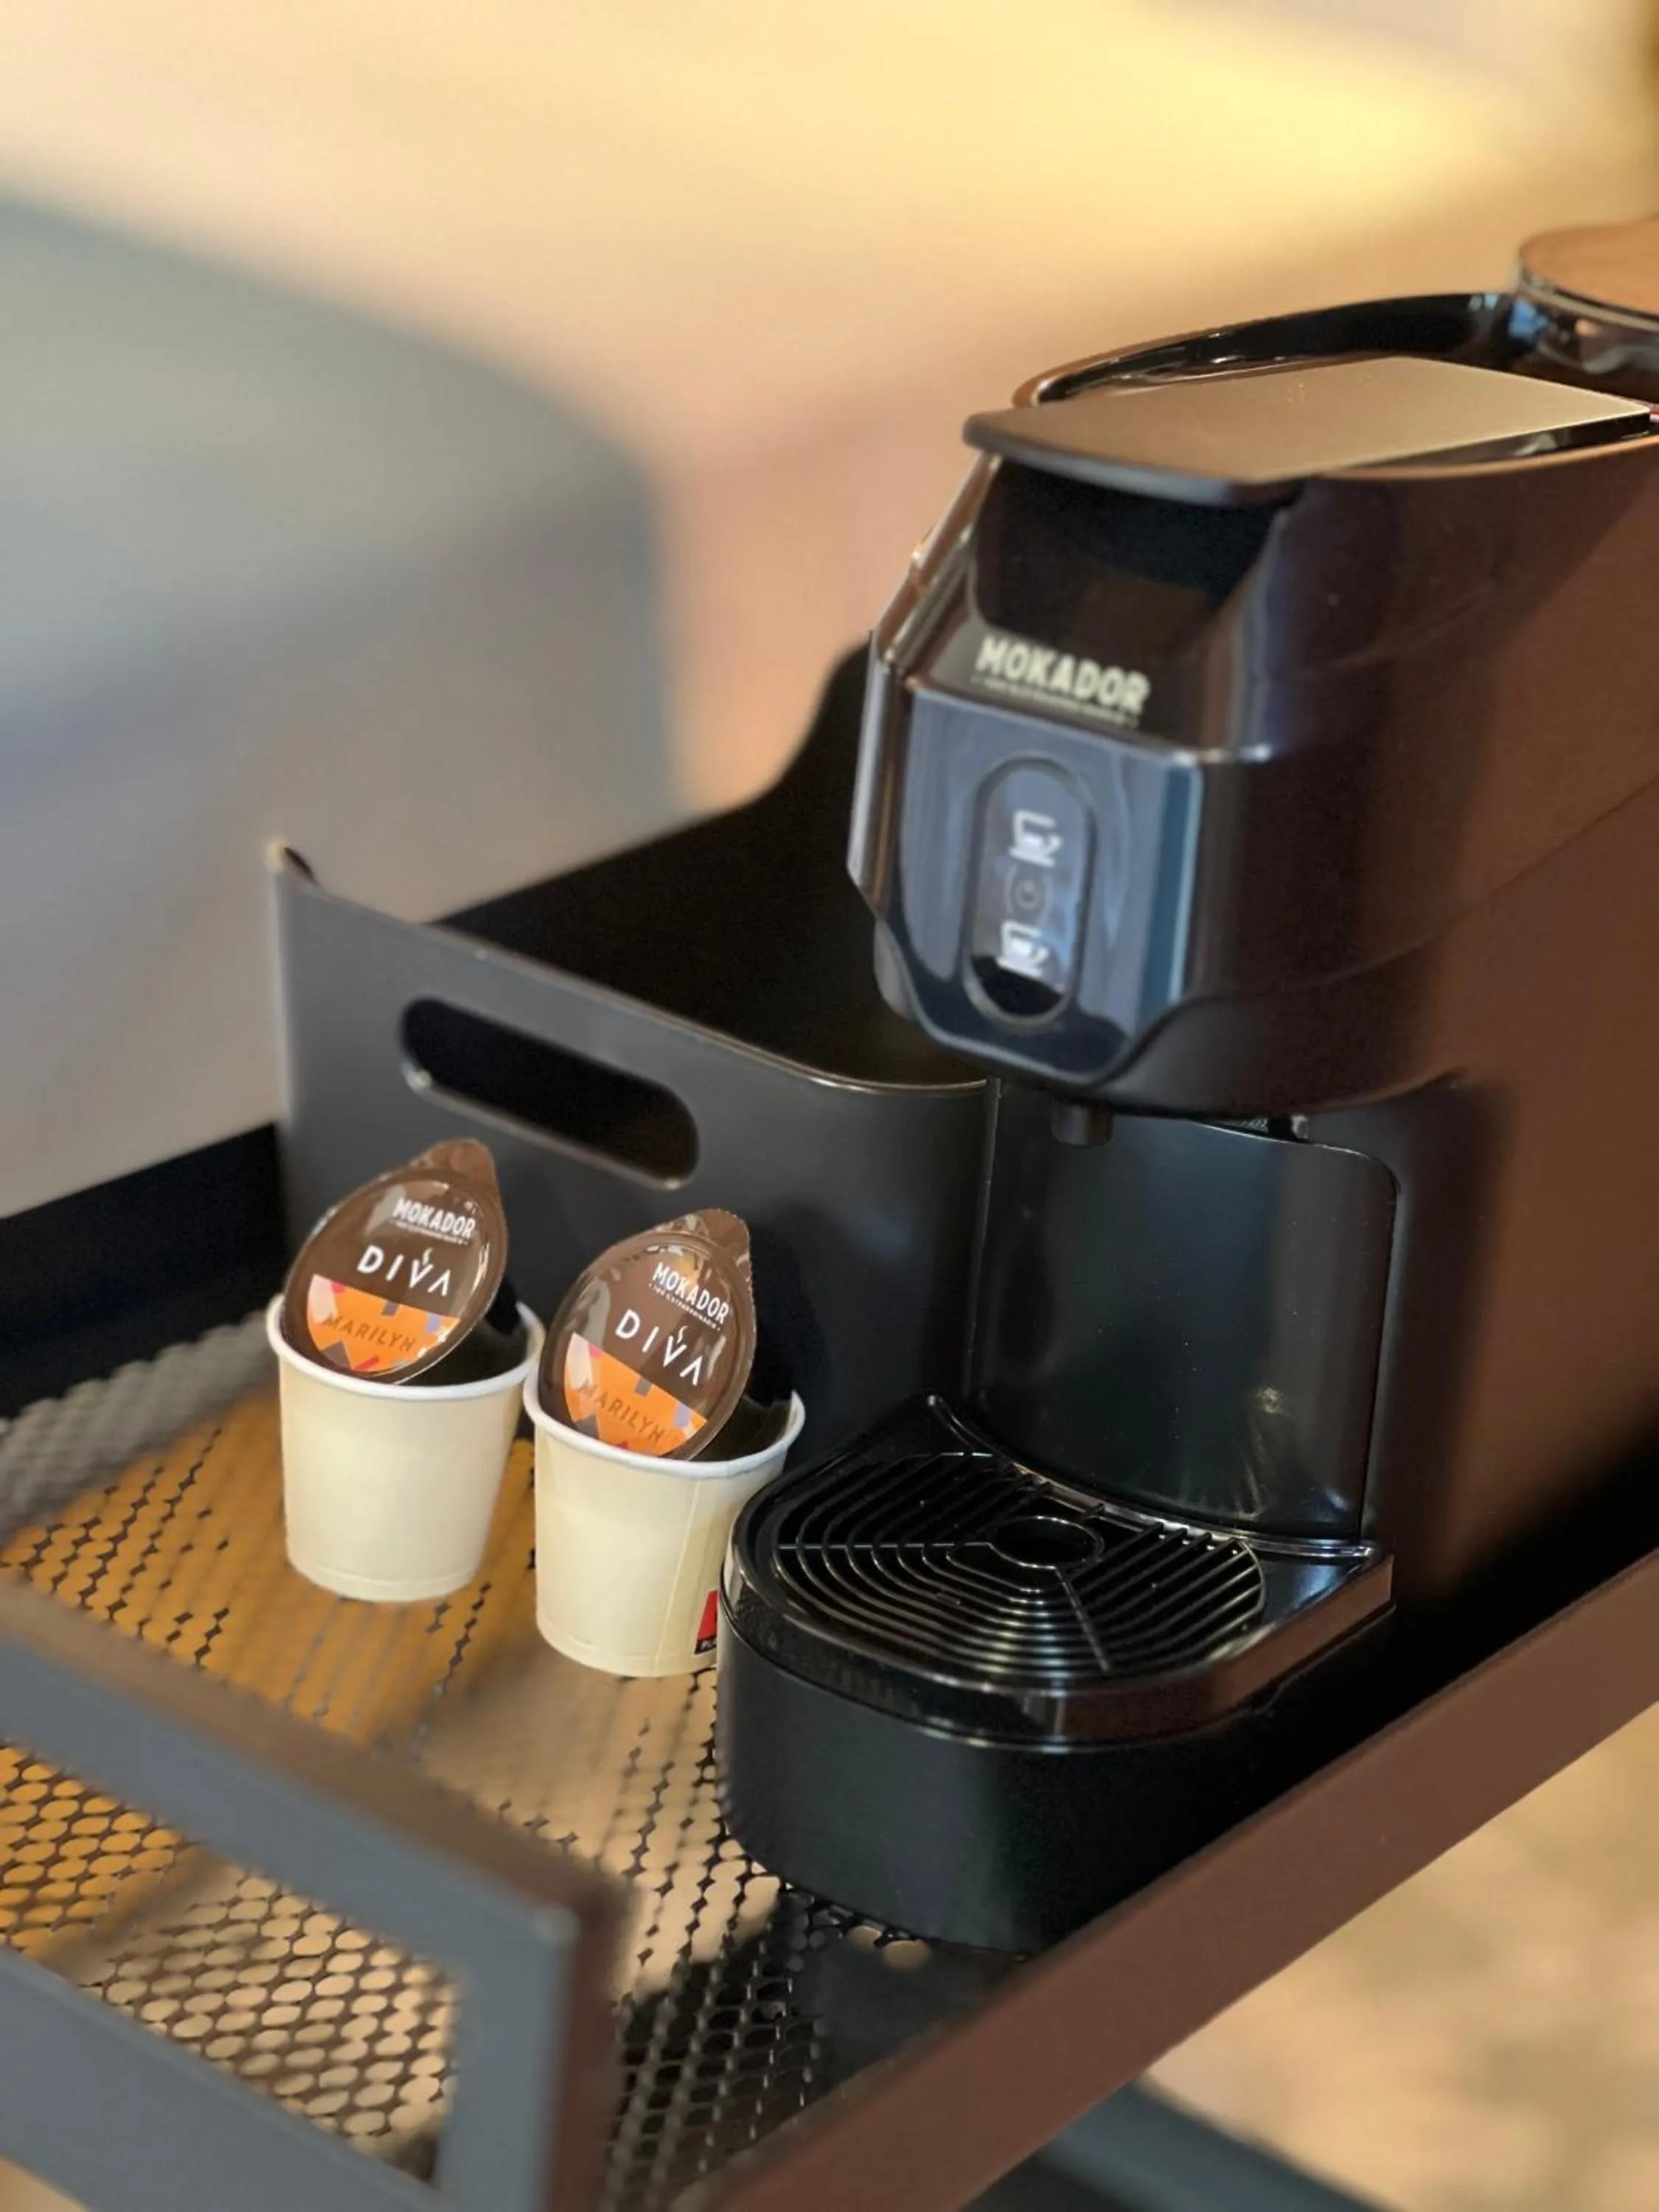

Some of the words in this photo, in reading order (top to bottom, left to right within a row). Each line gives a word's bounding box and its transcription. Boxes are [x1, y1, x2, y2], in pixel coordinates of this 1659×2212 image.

[974, 633, 1151, 714] MOKADOR
[393, 1197, 476, 1238] MOKADOR
[357, 1245, 451, 1297] DIVA
[652, 1262, 729, 1324] MOKADOR
[323, 1312, 417, 1352] MARILYN
[615, 1309, 703, 1386] DIVA
[578, 1379, 666, 1442] MARILYN
